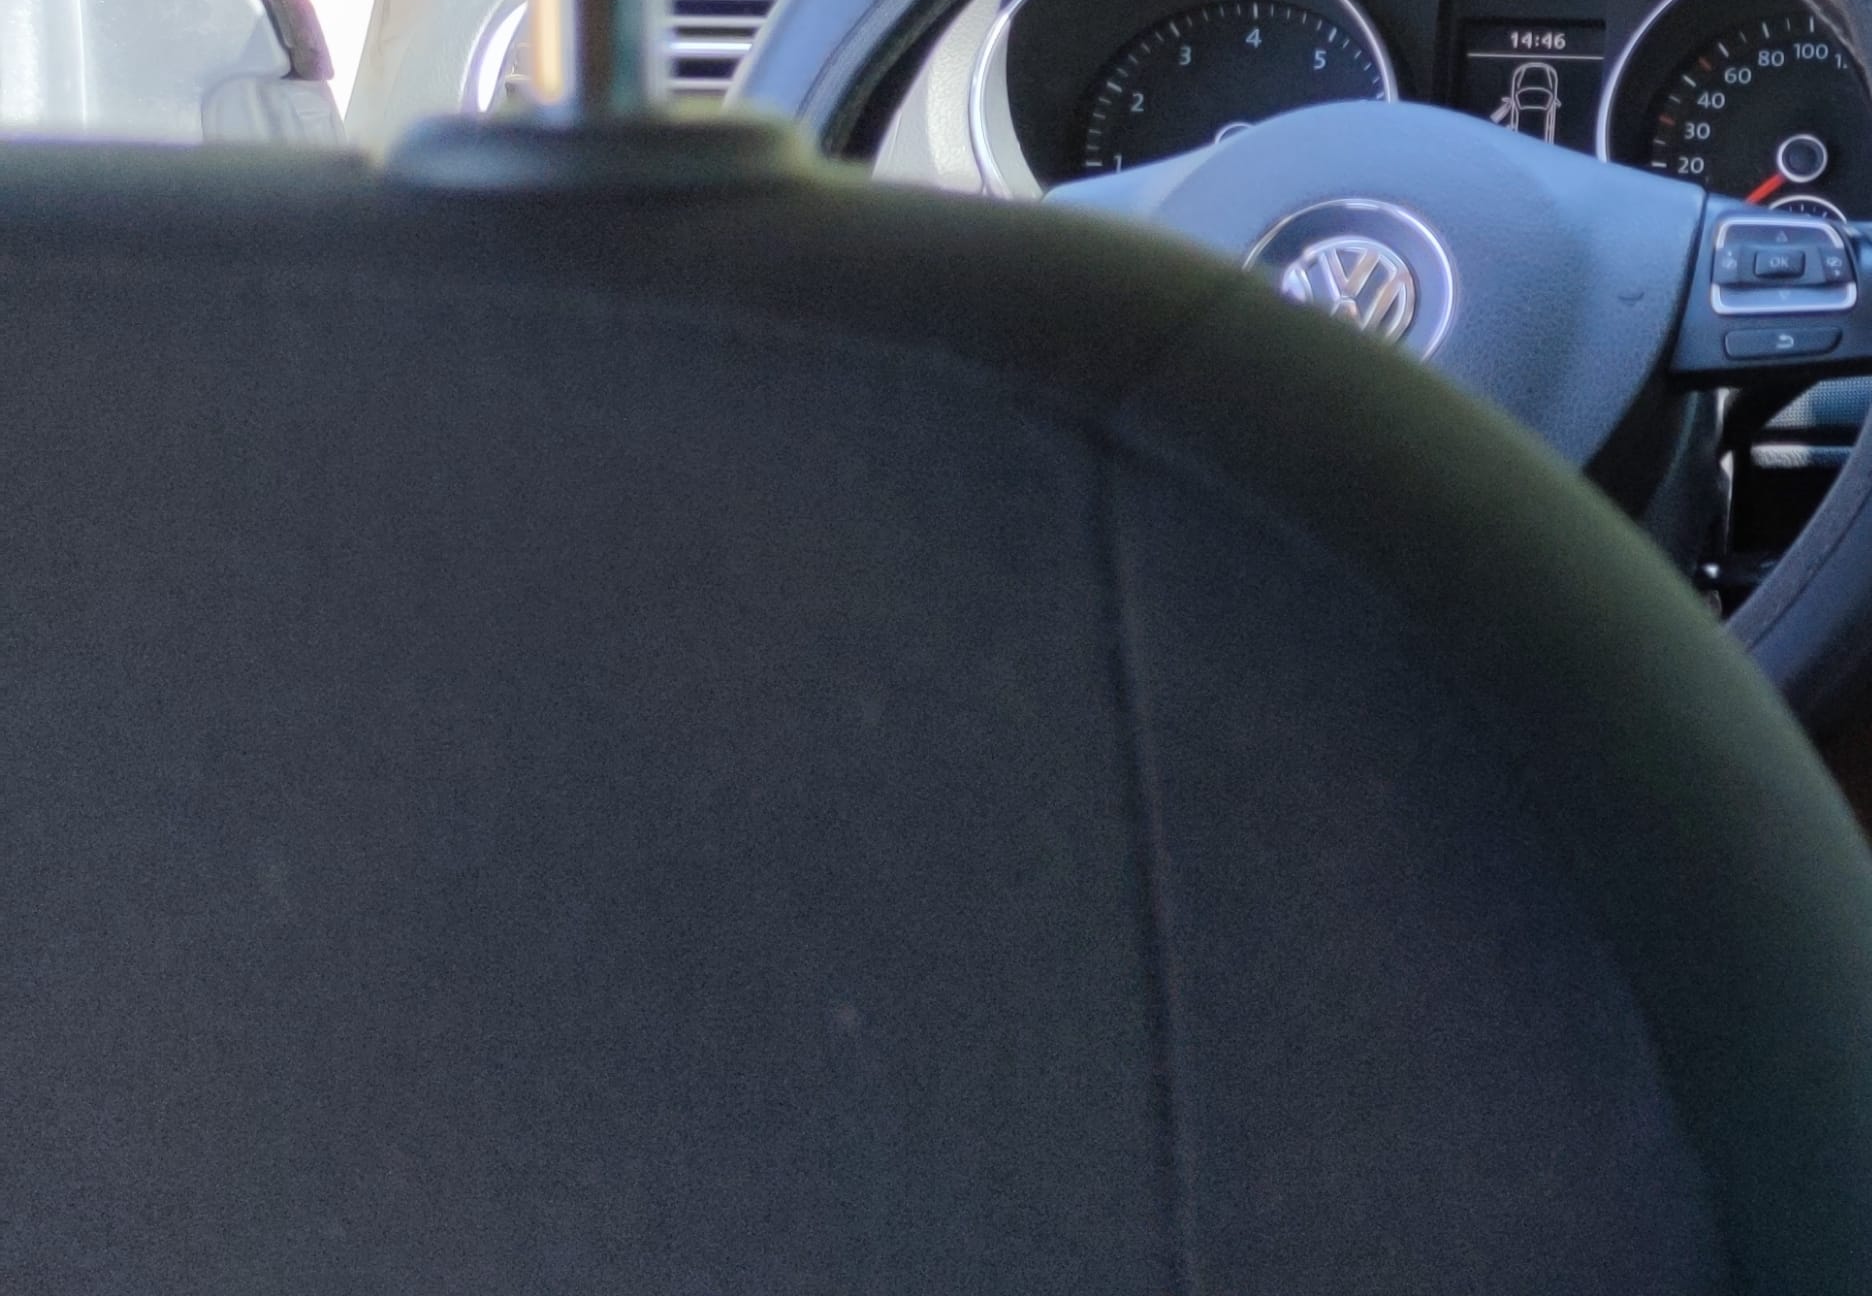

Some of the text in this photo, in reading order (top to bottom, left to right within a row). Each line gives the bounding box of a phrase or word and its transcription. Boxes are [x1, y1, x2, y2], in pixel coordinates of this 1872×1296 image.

[1245, 27, 1262, 48] 4
[1510, 30, 1567, 50] 14:46
[1178, 46, 1192, 66] 3
[1313, 50, 1327, 70] 5
[1757, 50, 1785, 67] 80
[1792, 42, 1829, 60] 100
[1724, 67, 1752, 84] 60
[1130, 92, 1145, 113] 2
[1697, 91, 1726, 109] 40
[1683, 122, 1711, 140] 30
[1113, 154, 1123, 173] 1
[1677, 156, 1705, 174] 20
[1768, 256, 1790, 269] OK
